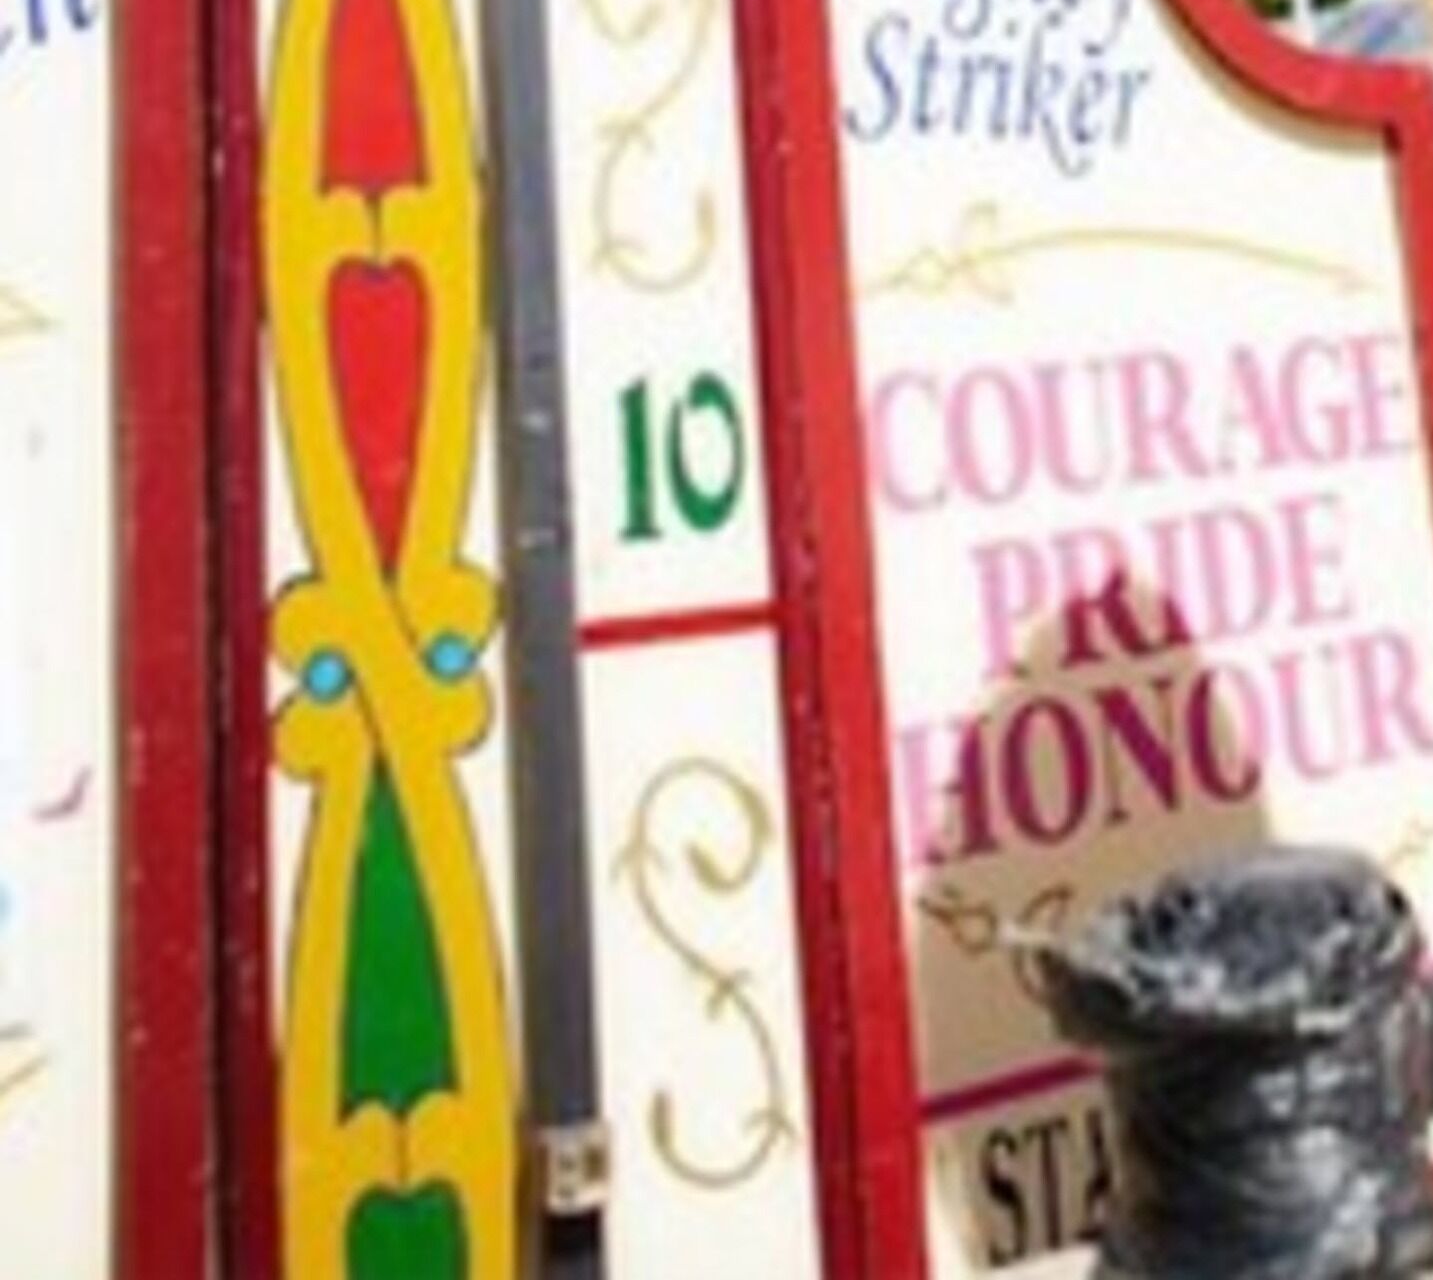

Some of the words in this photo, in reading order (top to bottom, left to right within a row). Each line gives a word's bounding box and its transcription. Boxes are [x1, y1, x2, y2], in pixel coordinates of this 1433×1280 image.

[842, 9, 1152, 178] Striker
[618, 370, 743, 542] 10
[871, 333, 1418, 513] COURAGE
[969, 492, 1356, 683] PRIDE
